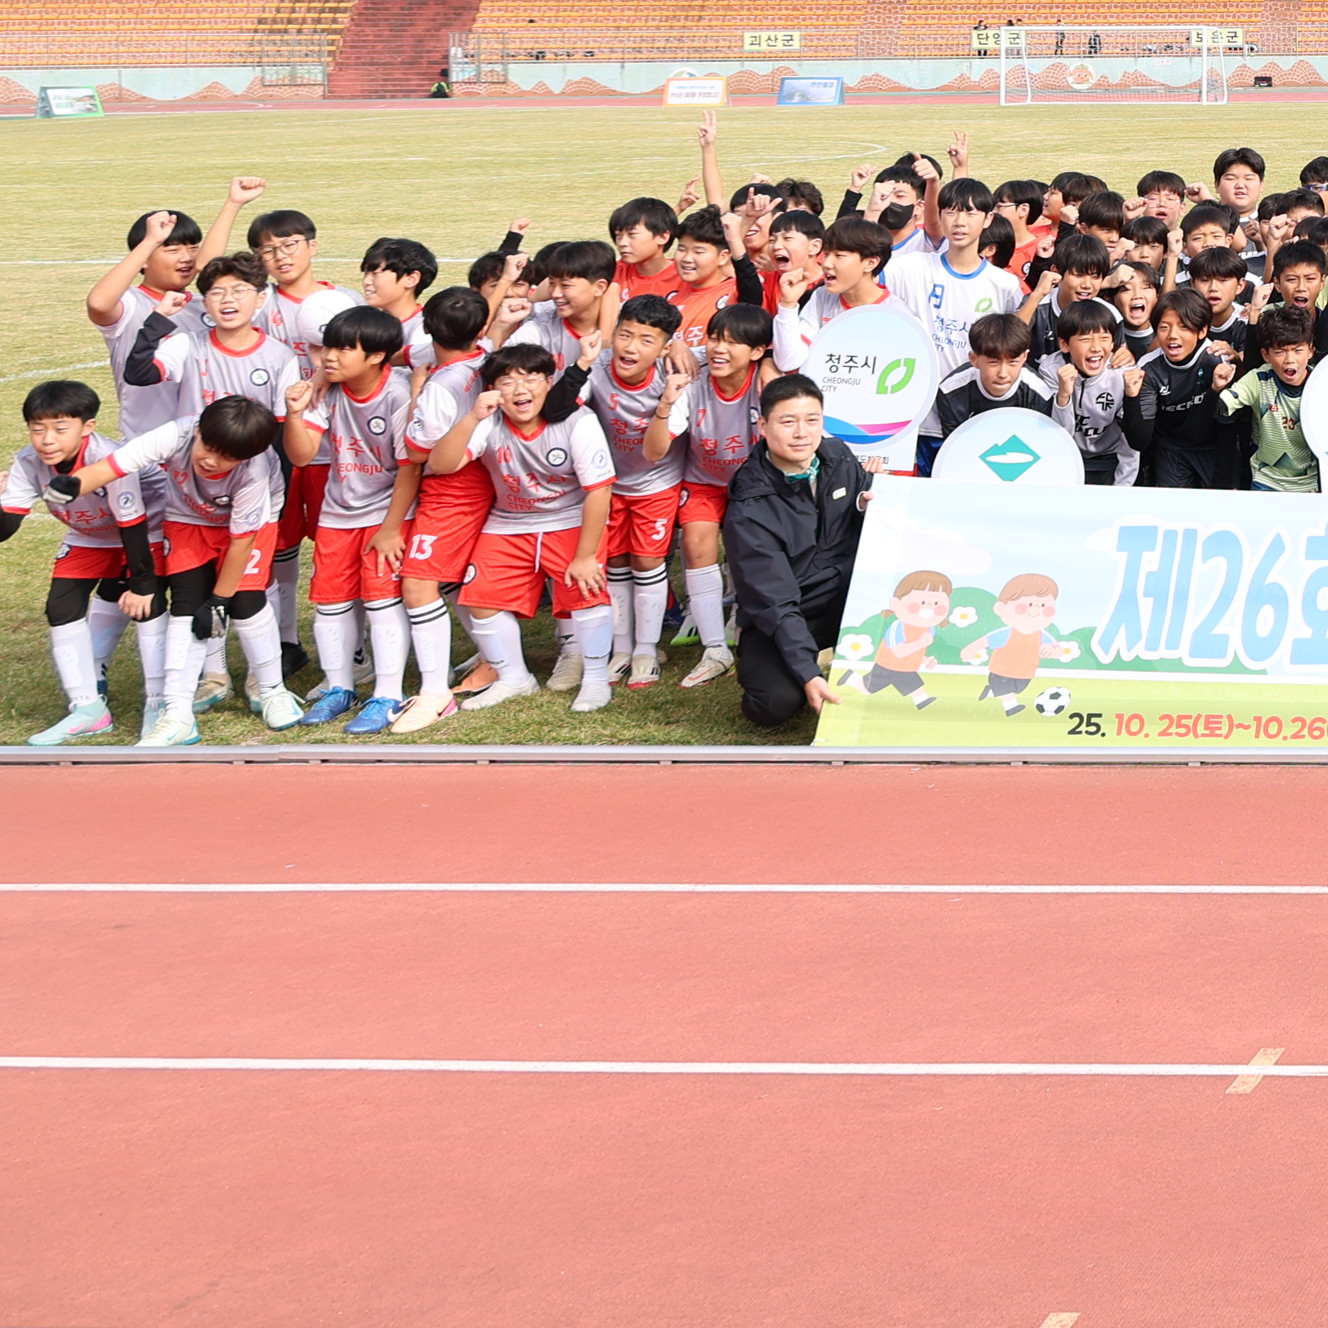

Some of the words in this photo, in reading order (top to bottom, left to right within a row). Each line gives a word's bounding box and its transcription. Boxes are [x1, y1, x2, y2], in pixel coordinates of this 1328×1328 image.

[750, 34, 795, 48] 괴산군
[825, 353, 876, 375] 청주시
[821, 384, 837, 393] CITY
[822, 376, 861, 386] CHEONGJU
[651, 518, 667, 541] 5
[410, 533, 437, 561] 13
[1067, 712, 1107, 738] 25.
[1115, 713, 1150, 738] 10.
